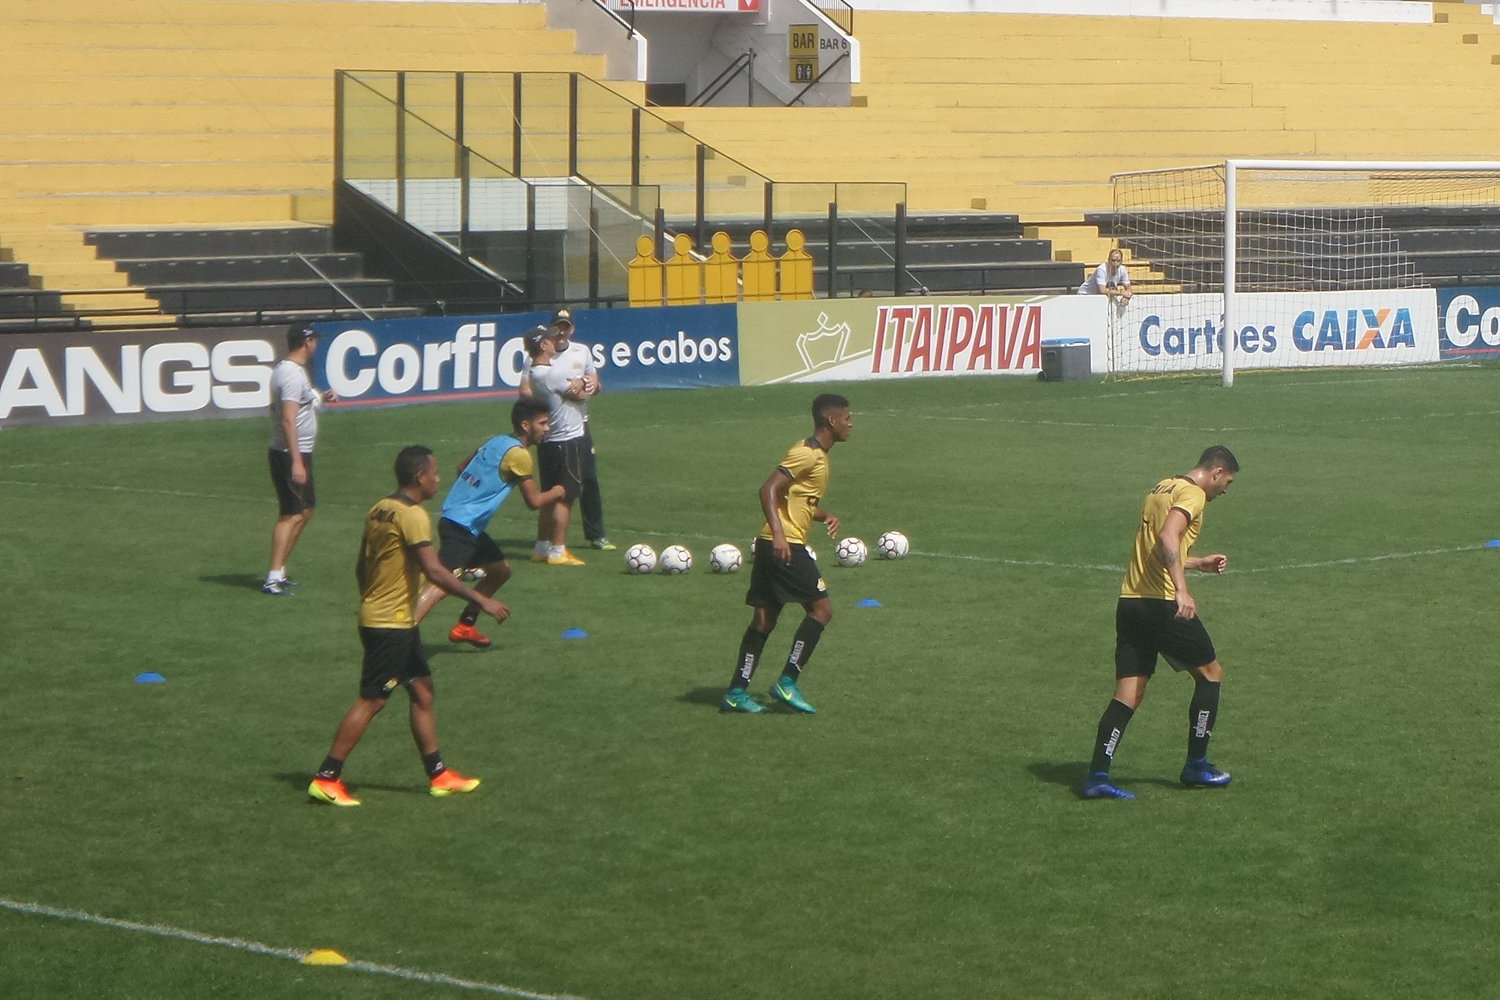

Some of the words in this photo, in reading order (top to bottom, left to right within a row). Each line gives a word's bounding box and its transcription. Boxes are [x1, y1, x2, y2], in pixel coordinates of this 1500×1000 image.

[793, 33, 815, 48] BAR
[820, 38, 839, 49] BAR
[841, 39, 848, 49] 6
[611, 345, 630, 367] e
[637, 331, 732, 366] cabos
[871, 304, 1044, 374] ITAIPAVA
[1292, 307, 1416, 353] CAIXA
[326, 323, 526, 398] Corfio
